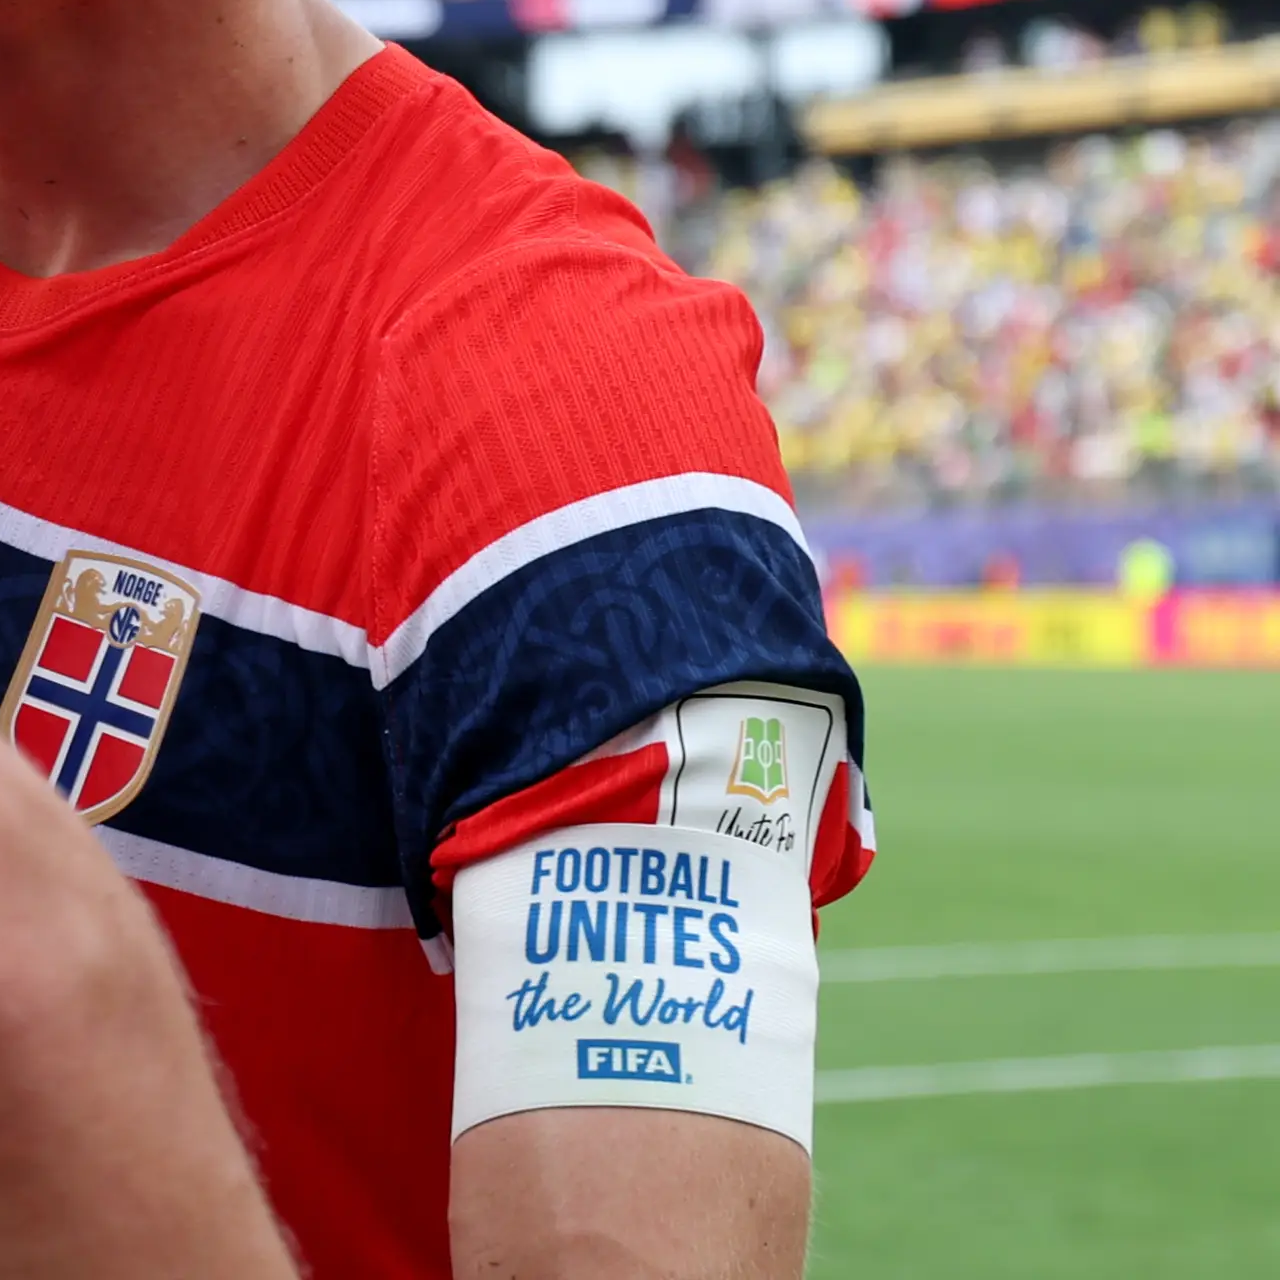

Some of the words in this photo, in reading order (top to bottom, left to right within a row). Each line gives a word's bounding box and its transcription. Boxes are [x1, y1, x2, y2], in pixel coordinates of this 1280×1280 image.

[112, 570, 163, 607] NORGE
[716, 806, 773, 847] Unite
[531, 846, 739, 908] FOOTBALL
[525, 900, 741, 974] UNITES
[506, 971, 592, 1032] the
[603, 972, 754, 1045] World
[586, 1046, 675, 1076] FIFA
